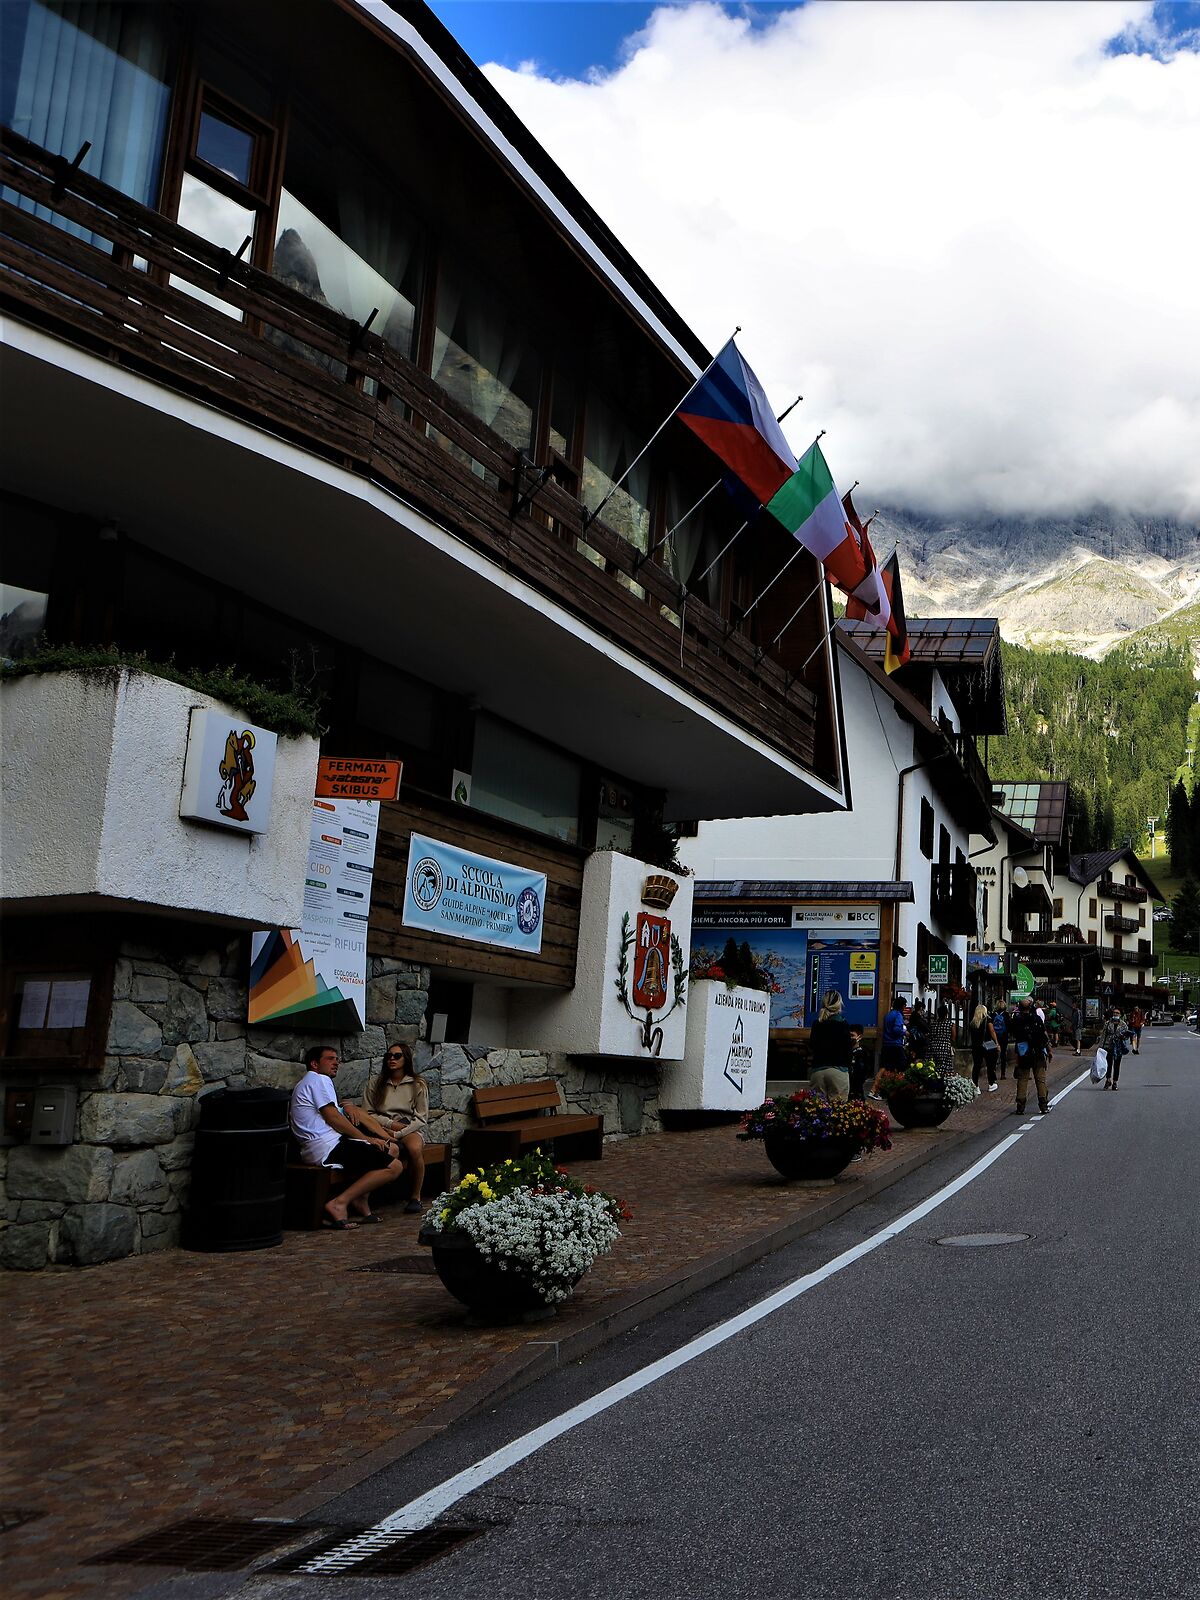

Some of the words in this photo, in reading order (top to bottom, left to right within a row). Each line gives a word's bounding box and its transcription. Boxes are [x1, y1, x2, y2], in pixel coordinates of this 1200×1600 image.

[328, 761, 387, 773] FERMATA
[331, 784, 379, 795] SKIBUS
[310, 862, 331, 875] CIBO
[461, 864, 503, 889] SCUOLA
[446, 875, 458, 892] DI
[460, 883, 516, 908] ALPINISMO
[442, 897, 463, 910] GUIDE
[464, 904, 486, 917] ALPINE
[302, 911, 334, 925] RASPORTI
[440, 910, 454, 921] SAN
[454, 913, 482, 927] MARTINO
[486, 921, 514, 934] PRIMIERO
[693, 917, 716, 925] SIEME,
[750, 915, 763, 924] PIÙ
[856, 912, 876, 921] BCC
[334, 938, 365, 953] RIFIUTI
[334, 969, 359, 979] ECOLOGICA
[339, 976, 364, 985] MONTAGNA
[715, 994, 734, 1010] AZIENDA
[734, 997, 743, 1010] PER
[743, 999, 748, 1011] IL
[748, 1000, 766, 1014] TURISMO
[731, 1032, 740, 1044] SAN
[731, 1046, 753, 1059] MARTINO
